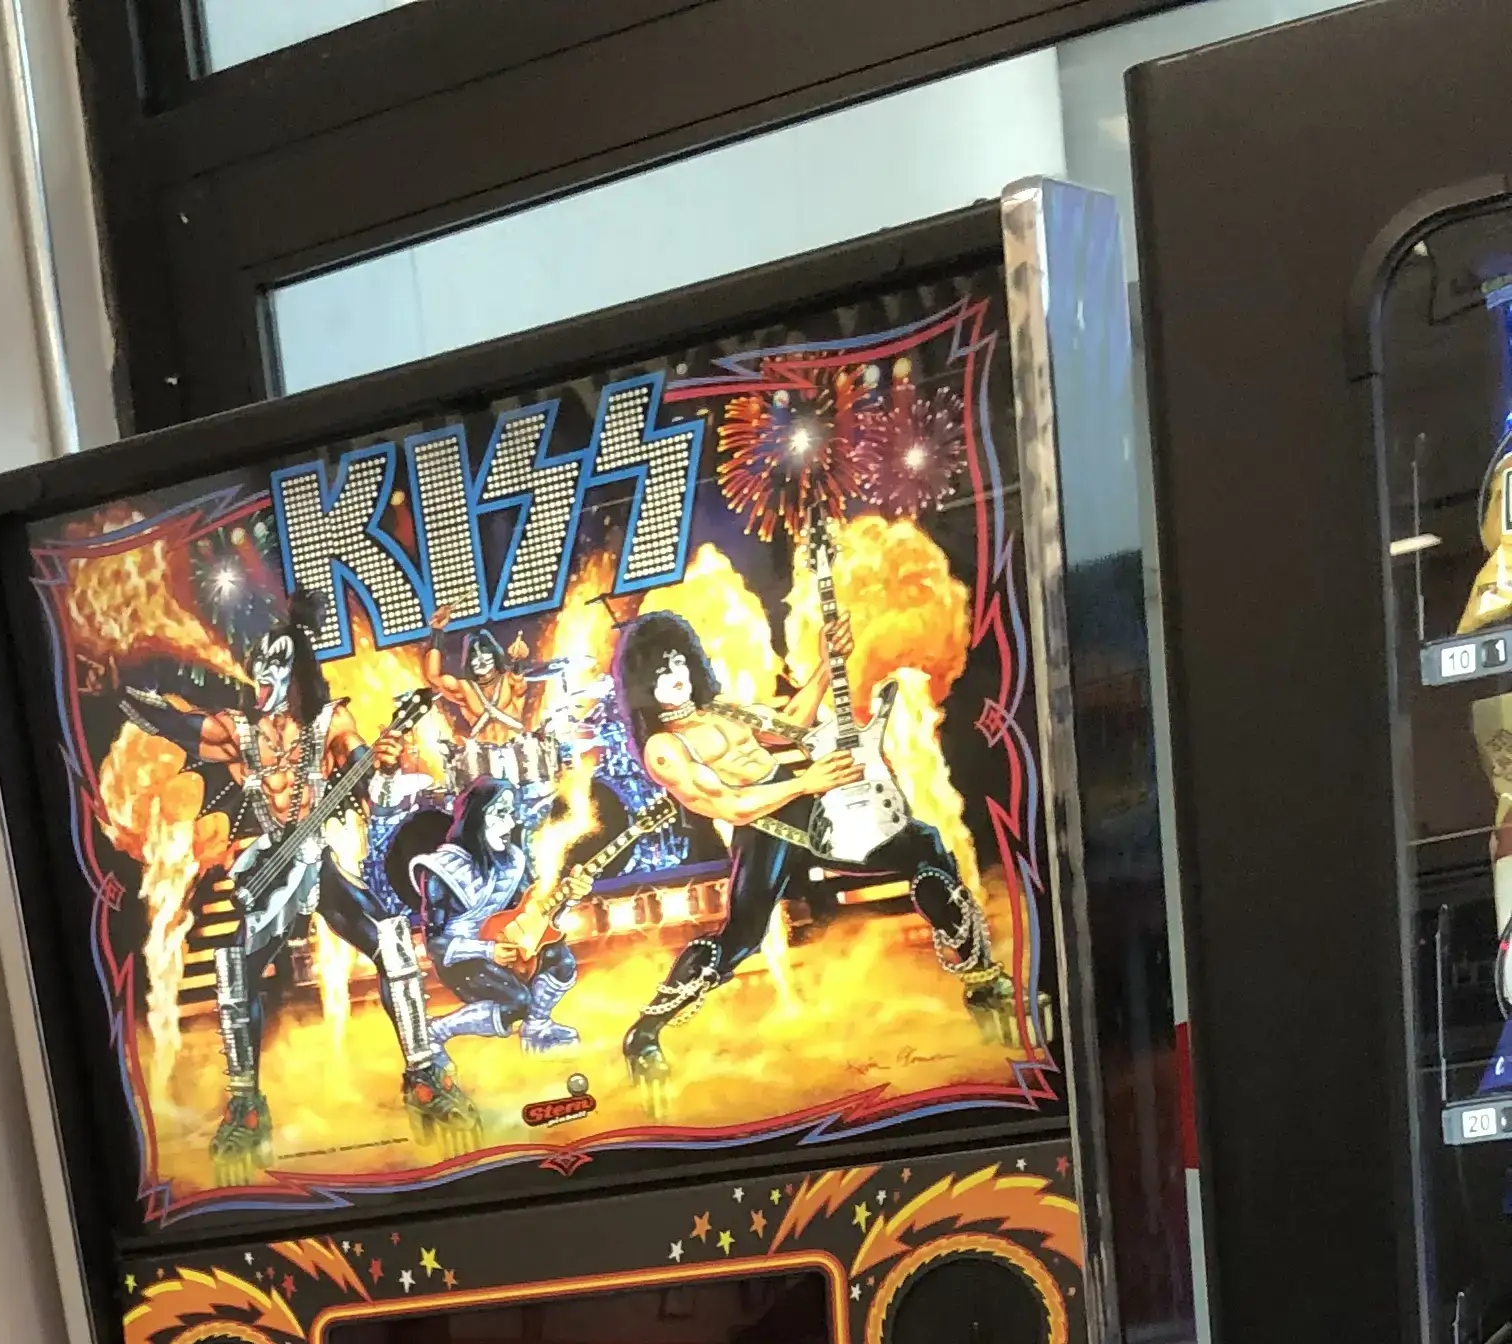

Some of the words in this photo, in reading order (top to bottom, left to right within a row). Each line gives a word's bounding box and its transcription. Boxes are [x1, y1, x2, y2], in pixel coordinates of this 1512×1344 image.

[270, 371, 705, 661] KISS
[1448, 649, 1470, 671] 10
[529, 1099, 590, 1121] Stern
[1468, 1113, 1490, 1133] 20
